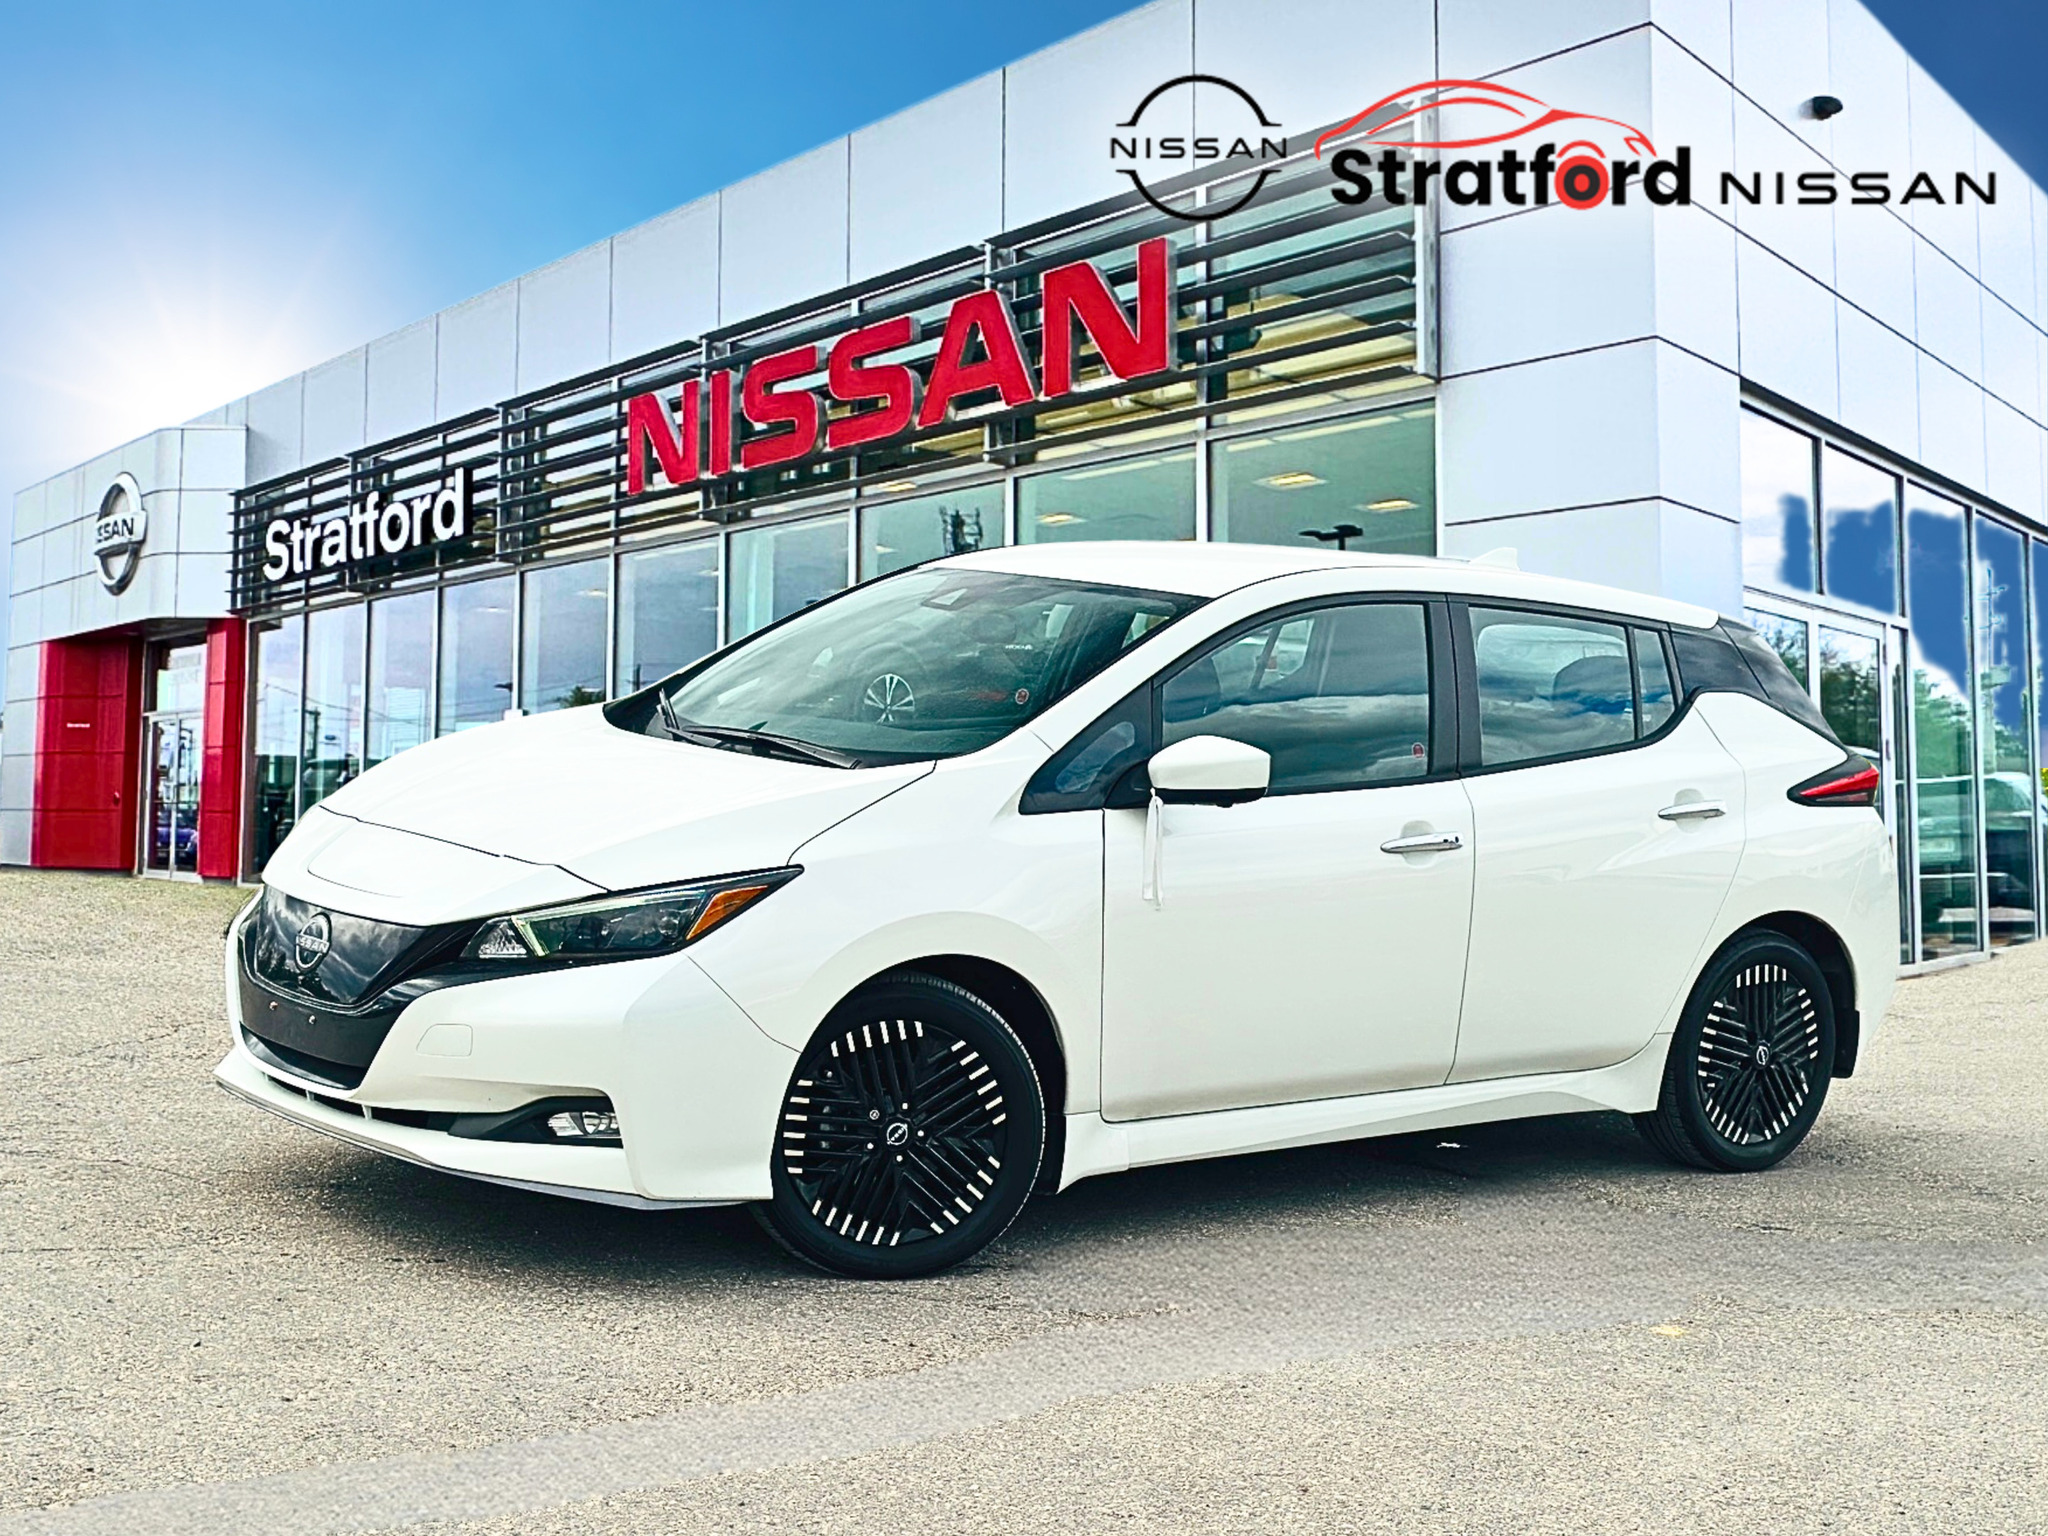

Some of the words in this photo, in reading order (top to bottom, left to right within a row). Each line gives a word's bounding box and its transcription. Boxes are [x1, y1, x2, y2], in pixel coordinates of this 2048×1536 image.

[627, 237, 1169, 496] NISSAN
[97, 517, 134, 543] SSAN
[263, 467, 465, 581] Stratford
